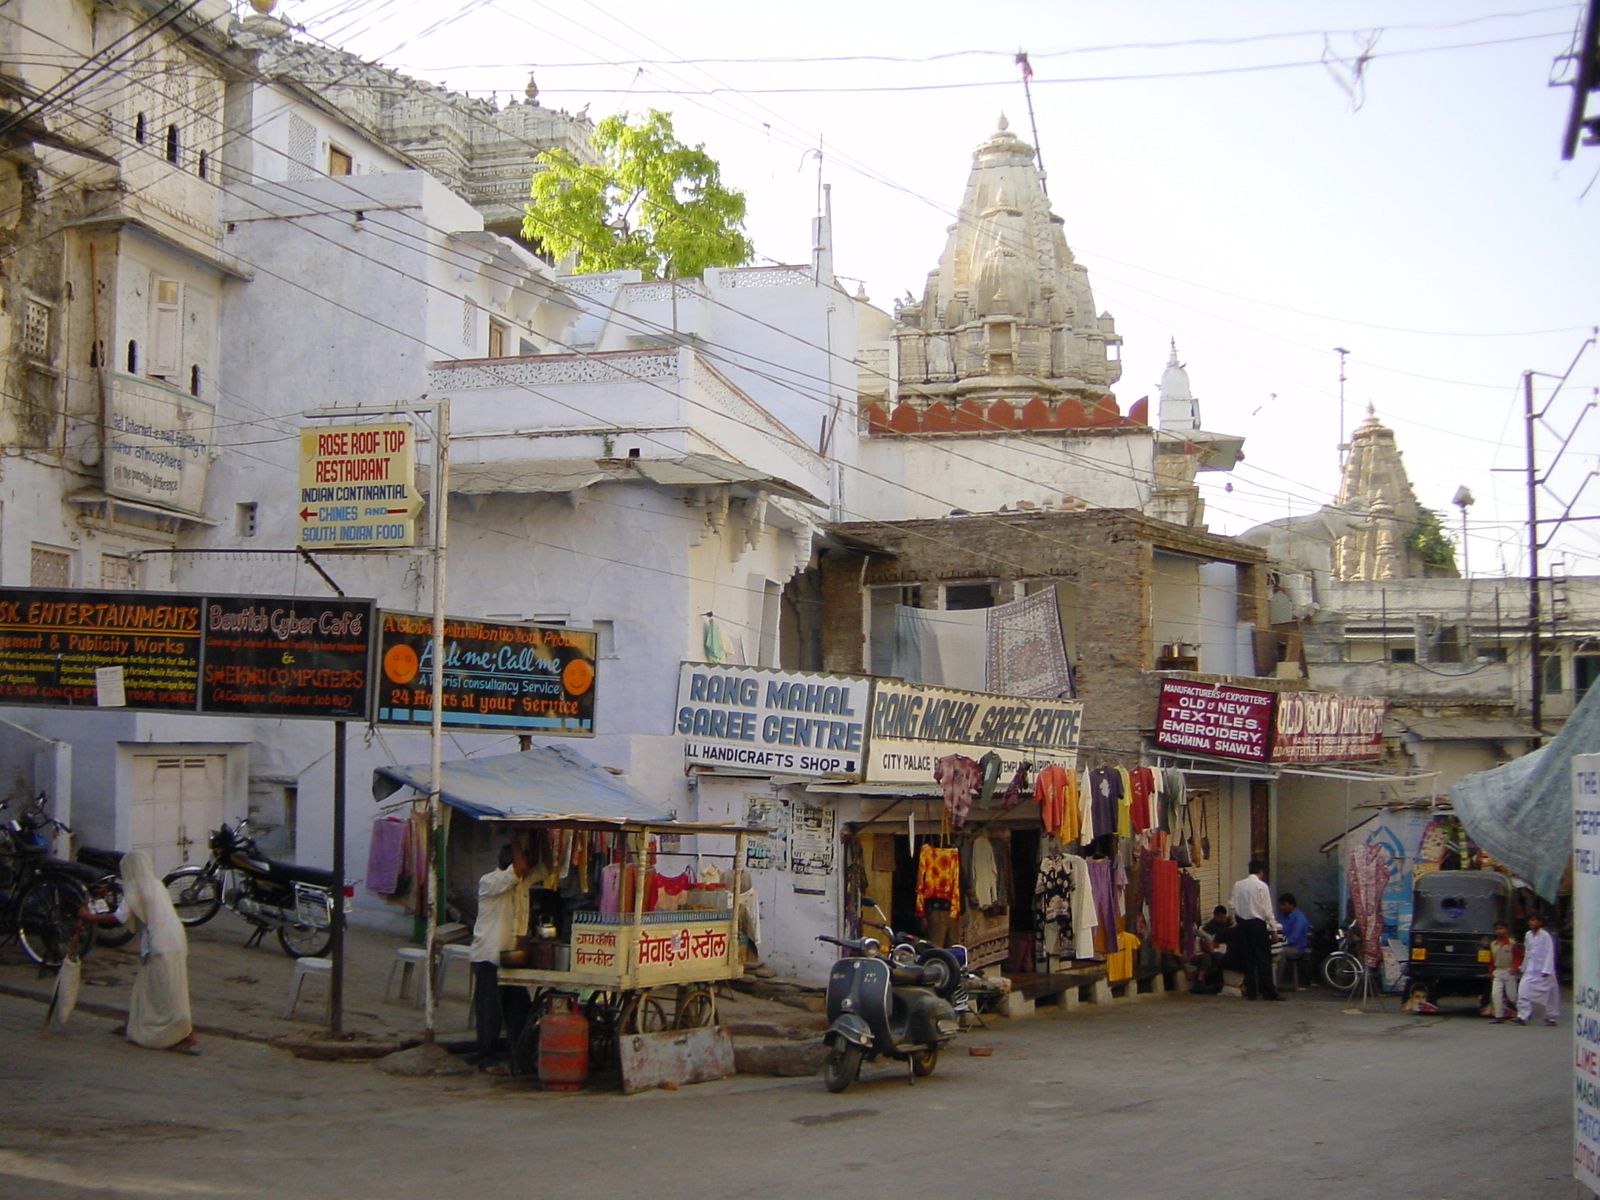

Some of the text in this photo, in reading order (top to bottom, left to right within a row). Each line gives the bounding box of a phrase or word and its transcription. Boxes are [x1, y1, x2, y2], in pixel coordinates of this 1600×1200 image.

[318, 430, 405, 457] ROSE ROOF TOP
[315, 457, 391, 483] RESTAURANT
[301, 484, 408, 503] INDIAN CONTINANTIAL
[318, 506, 388, 522] CHINIES AND
[302, 524, 405, 542] SOUTH INDIAN FOOD
[27, 601, 200, 630] ENTERTAINMENTS
[270, 608, 317, 640] Cyber
[318, 611, 364, 636] Café
[384, 616, 395, 632] A
[397, 617, 433, 635] Globa
[49, 634, 60, 650] &
[67, 634, 129, 656] Publicity
[133, 637, 185, 654] Works
[419, 639, 462, 669] Ak
[497, 645, 535, 672] Call
[535, 657, 562, 673] me
[267, 667, 364, 689] COMPUTERS
[419, 675, 427, 686] A
[463, 678, 519, 696] consultancy
[522, 680, 560, 694] Service
[127, 690, 156, 701] YOUR
[225, 690, 266, 705] Complete
[267, 692, 312, 706] Computer
[391, 689, 579, 714] 24 Hors at your Service
[690, 673, 856, 718] RANG MAHAL
[1164, 683, 1220, 699] MANUFACTURERS
[1179, 697, 1206, 710] OLD
[1218, 702, 1251, 716] NEW
[1277, 700, 1305, 735] OLD
[1306, 700, 1339, 735] GOLD
[677, 706, 863, 754] SAREE CENTRE
[873, 691, 1082, 750] RANG MAHAL SAREE CENTRE
[1167, 707, 1262, 731] TEXTILES.
[1162, 719, 1262, 744] EMBROIDERY.
[1159, 731, 1264, 757] PASHMINA SHAWLS.
[702, 745, 794, 768] HANDICRAFTS
[882, 753, 902, 770] CITY
[903, 756, 931, 771] PALACE
[1577, 771, 1597, 794] THE
[1575, 848, 1590, 872] THE
[691, 928, 727, 959] स्टॉल
[1575, 1044, 1598, 1077] LIME
